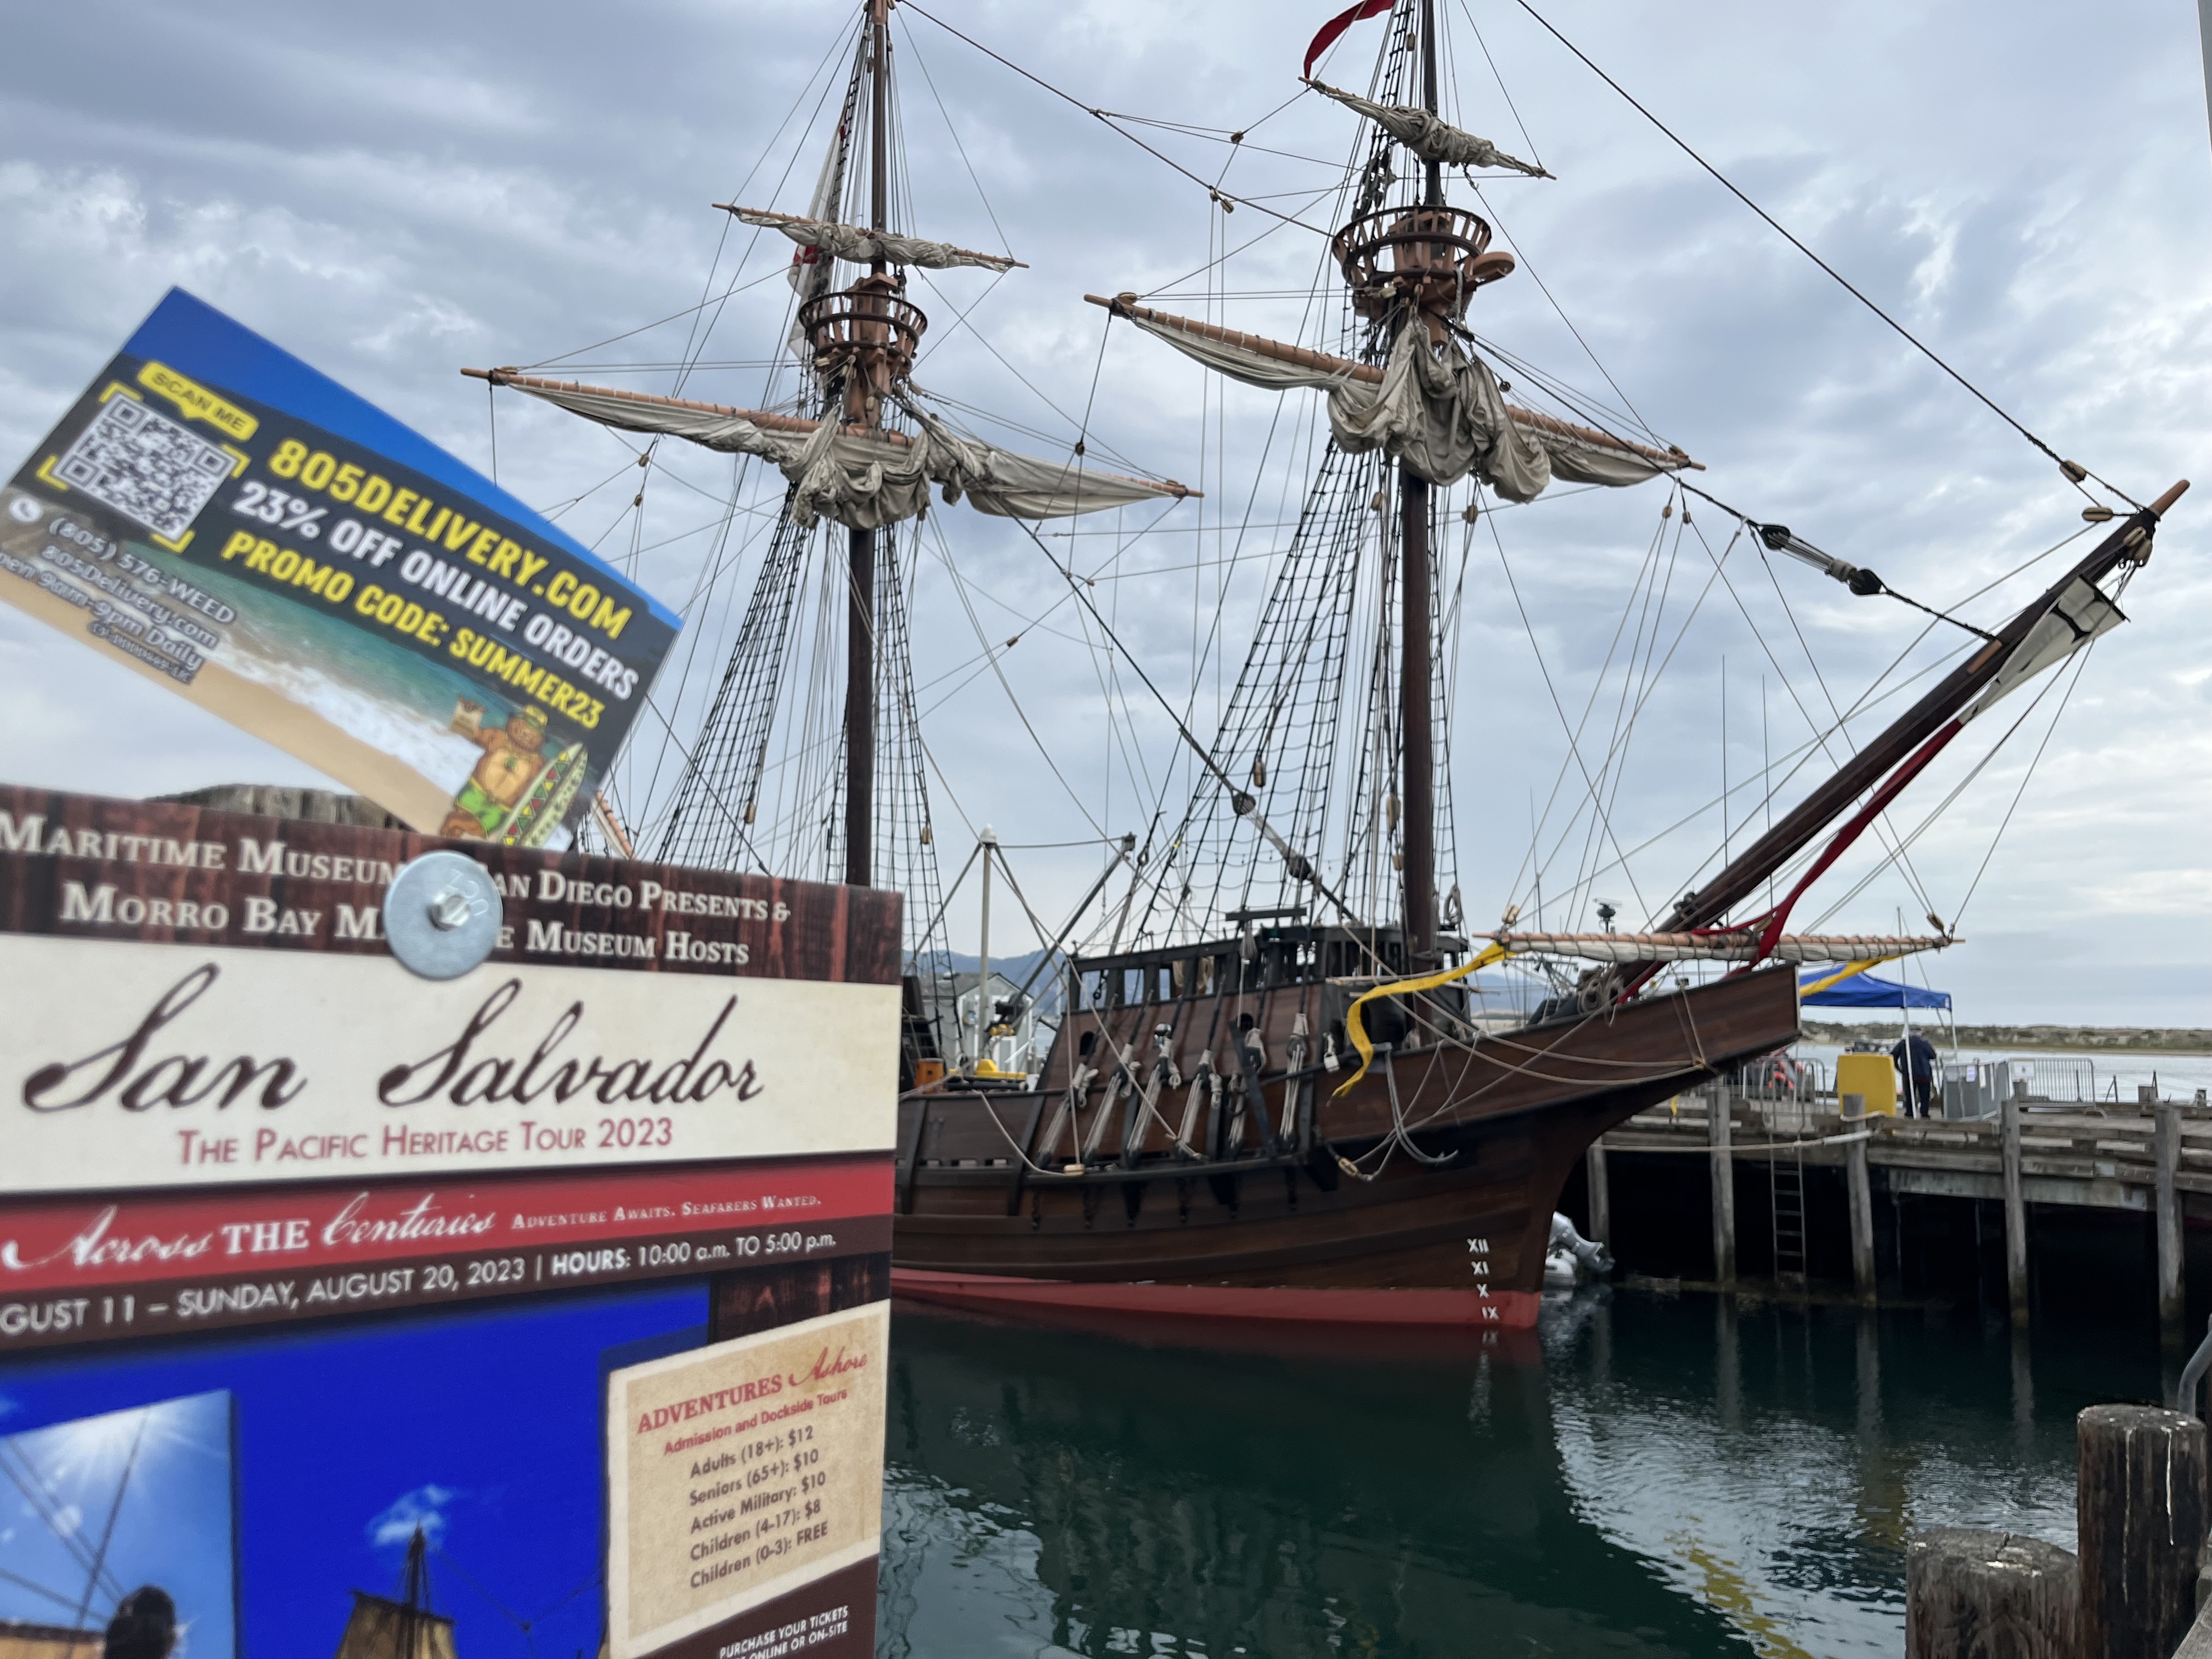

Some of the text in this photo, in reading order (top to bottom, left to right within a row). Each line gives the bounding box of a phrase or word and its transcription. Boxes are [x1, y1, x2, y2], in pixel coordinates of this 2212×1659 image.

[152, 373, 246, 431] SCAN ME
[49, 517, 234, 623] (805) 576-WEED
[269, 439, 633, 640] 805DELIVERY.COM
[42, 545, 219, 648] 805Delivery.com
[233, 481, 639, 699] 23% OFF ONLINE ORDERS
[145, 627, 202, 671] Daily
[222, 532, 606, 729] PROMO CODE: SUMMER23
[0, 809, 228, 870] MARITIME
[538, 870, 633, 909] DIEGO
[639, 882, 768, 919] PRESENTS
[772, 901, 790, 921] &
[59, 879, 229, 929] MORRO
[242, 898, 322, 936] BAY
[527, 918, 656, 958] MUSEUM
[664, 932, 749, 964] HOSTS
[22, 962, 764, 1113] San Salvador
[177, 1118, 673, 1165] THE PACIFIC HERITAGE TOUR 2023
[1, 1205, 214, 1269] Across
[223, 1220, 310, 1255] THE
[321, 1191, 496, 1246] Centuries
[511, 1211, 607, 1229] ADVENTURE
[681, 1200, 757, 1216] SEAFARERS
[1466, 1238, 1489, 1254] XII
[103, 1295, 135, 1324] 11
[177, 1279, 299, 1317] SUNDAY,
[307, 1269, 415, 1304] AUGUST
[421, 1263, 459, 1292] 20,
[468, 1257, 524, 1288] 2023
[552, 1249, 631, 1276] HOURS:
[637, 1242, 691, 1266] 10:00
[696, 1243, 730, 1260] a.m.
[736, 1236, 760, 1256] TO
[766, 1232, 802, 1253] 5:00
[805, 1233, 836, 1251] p.m.
[1471, 1261, 1489, 1276] XI
[1476, 1283, 1490, 1299] X
[1482, 1306, 1499, 1319] IX
[637, 1347, 867, 1435] ADVENTURES Ashore
[664, 1389, 848, 1457] Admission and Dockside Tours
[691, 1426, 813, 1479] Adults (18+): $12
[690, 1449, 819, 1506] Seniors (65+): $10
[691, 1472, 826, 1534] Active Military: $10
[690, 1499, 821, 1561] Children (4-17): $8
[690, 1521, 828, 1588] Children (0-3): FREE
[720, 1605, 848, 1659] PURCHASE YOUR TICKETS
[791, 1636, 805, 1650] OR
[809, 1621, 848, 1644] ON-SITE
